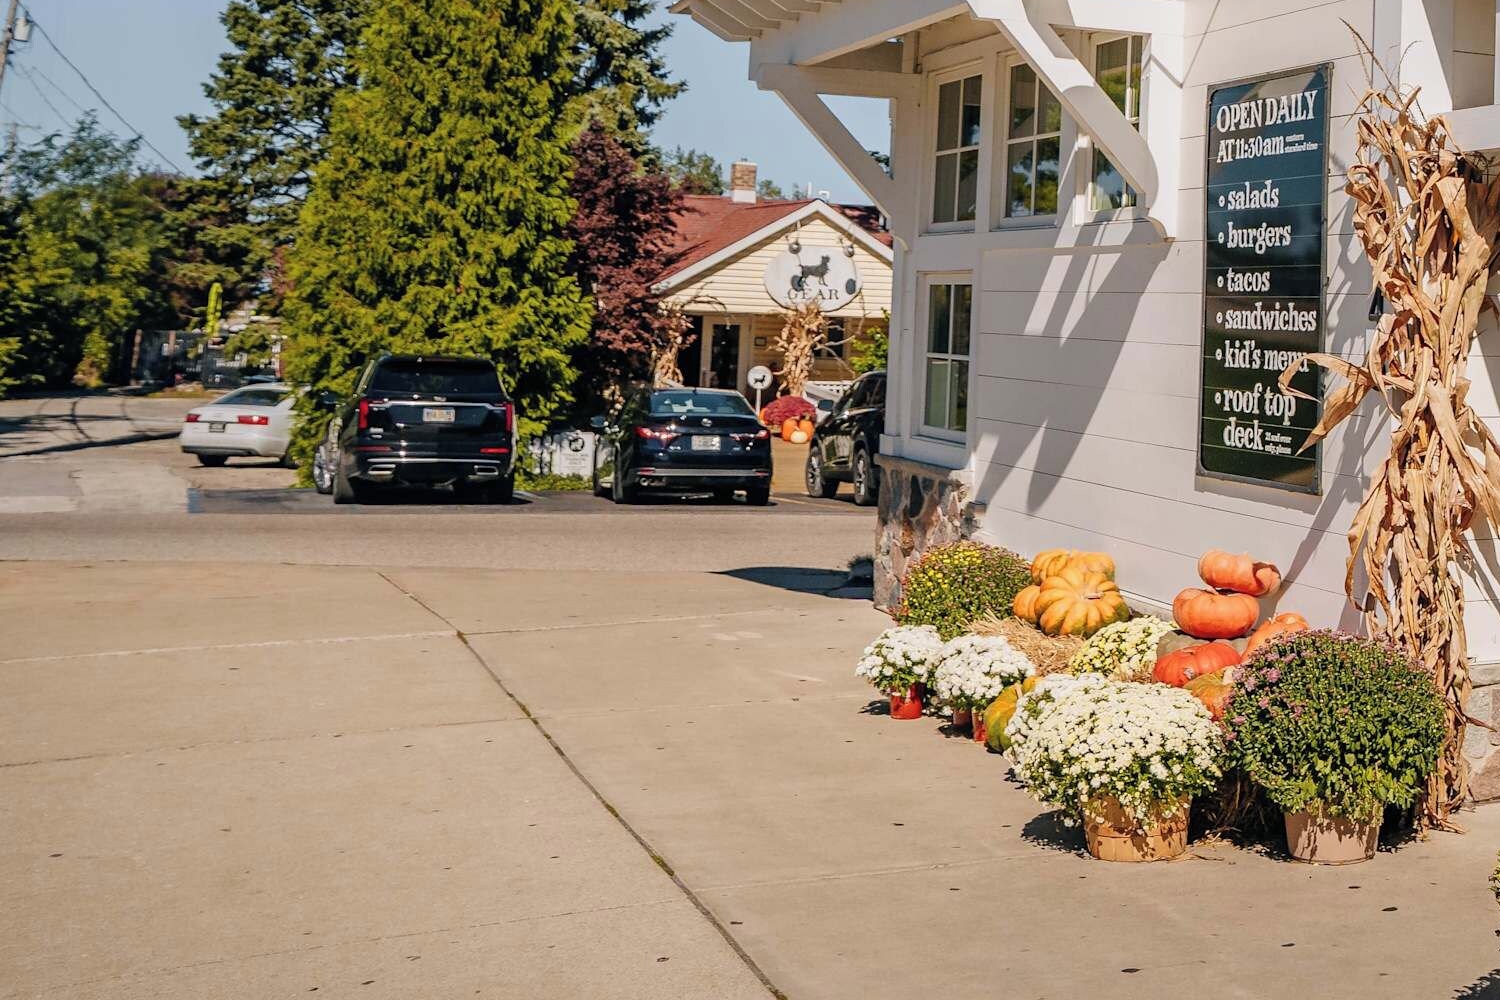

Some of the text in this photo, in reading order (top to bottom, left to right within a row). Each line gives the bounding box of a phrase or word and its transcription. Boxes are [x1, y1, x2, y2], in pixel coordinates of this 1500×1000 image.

[1216, 89, 1319, 133] OPEN DAILY
[1216, 138, 1236, 163] AT
[1227, 179, 1280, 210] salads
[1226, 221, 1292, 255] burgers
[787, 288, 840, 300] GEAR
[1226, 267, 1271, 292] tacos
[1223, 301, 1318, 332] sandwiches
[1223, 340, 1262, 369] kid's
[1223, 382, 1297, 426] roof top
[1223, 416, 1264, 451] deck
